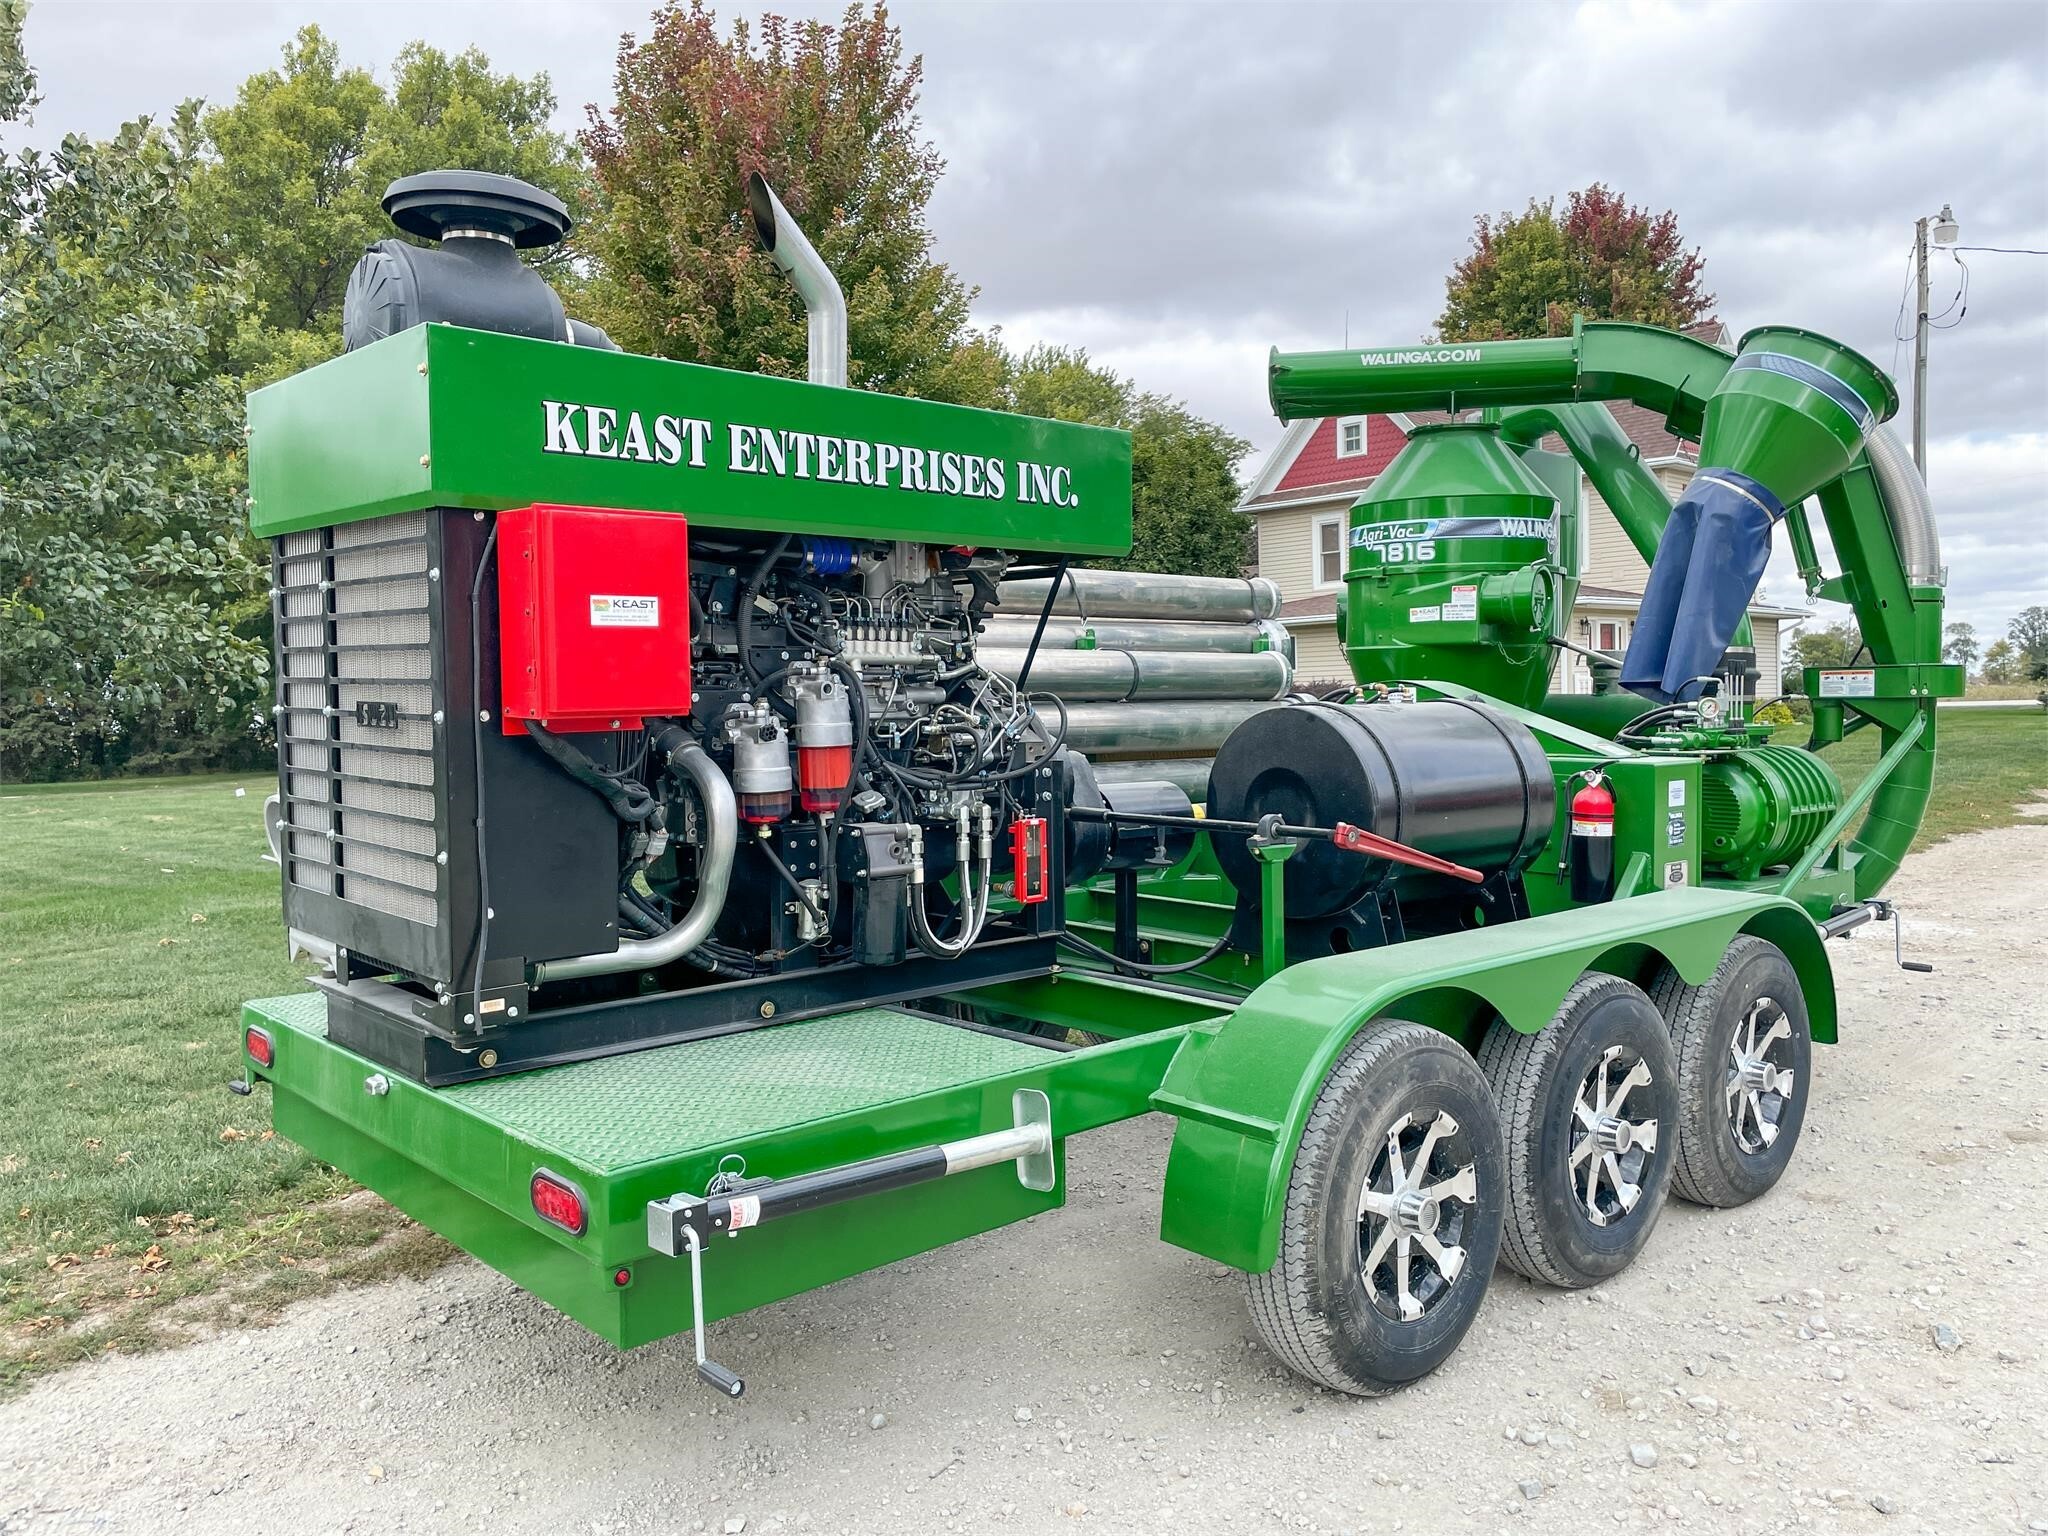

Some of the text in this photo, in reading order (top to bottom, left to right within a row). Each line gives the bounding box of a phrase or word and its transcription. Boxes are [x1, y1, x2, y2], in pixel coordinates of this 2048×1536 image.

[1360, 349, 1481, 366] WALINGA.COM
[542, 400, 1079, 507] KEAST ENTERPRISES INC.
[1361, 524, 1414, 551] Agri-Vac
[1372, 541, 1436, 563] 7816
[612, 599, 656, 608] KEAST
